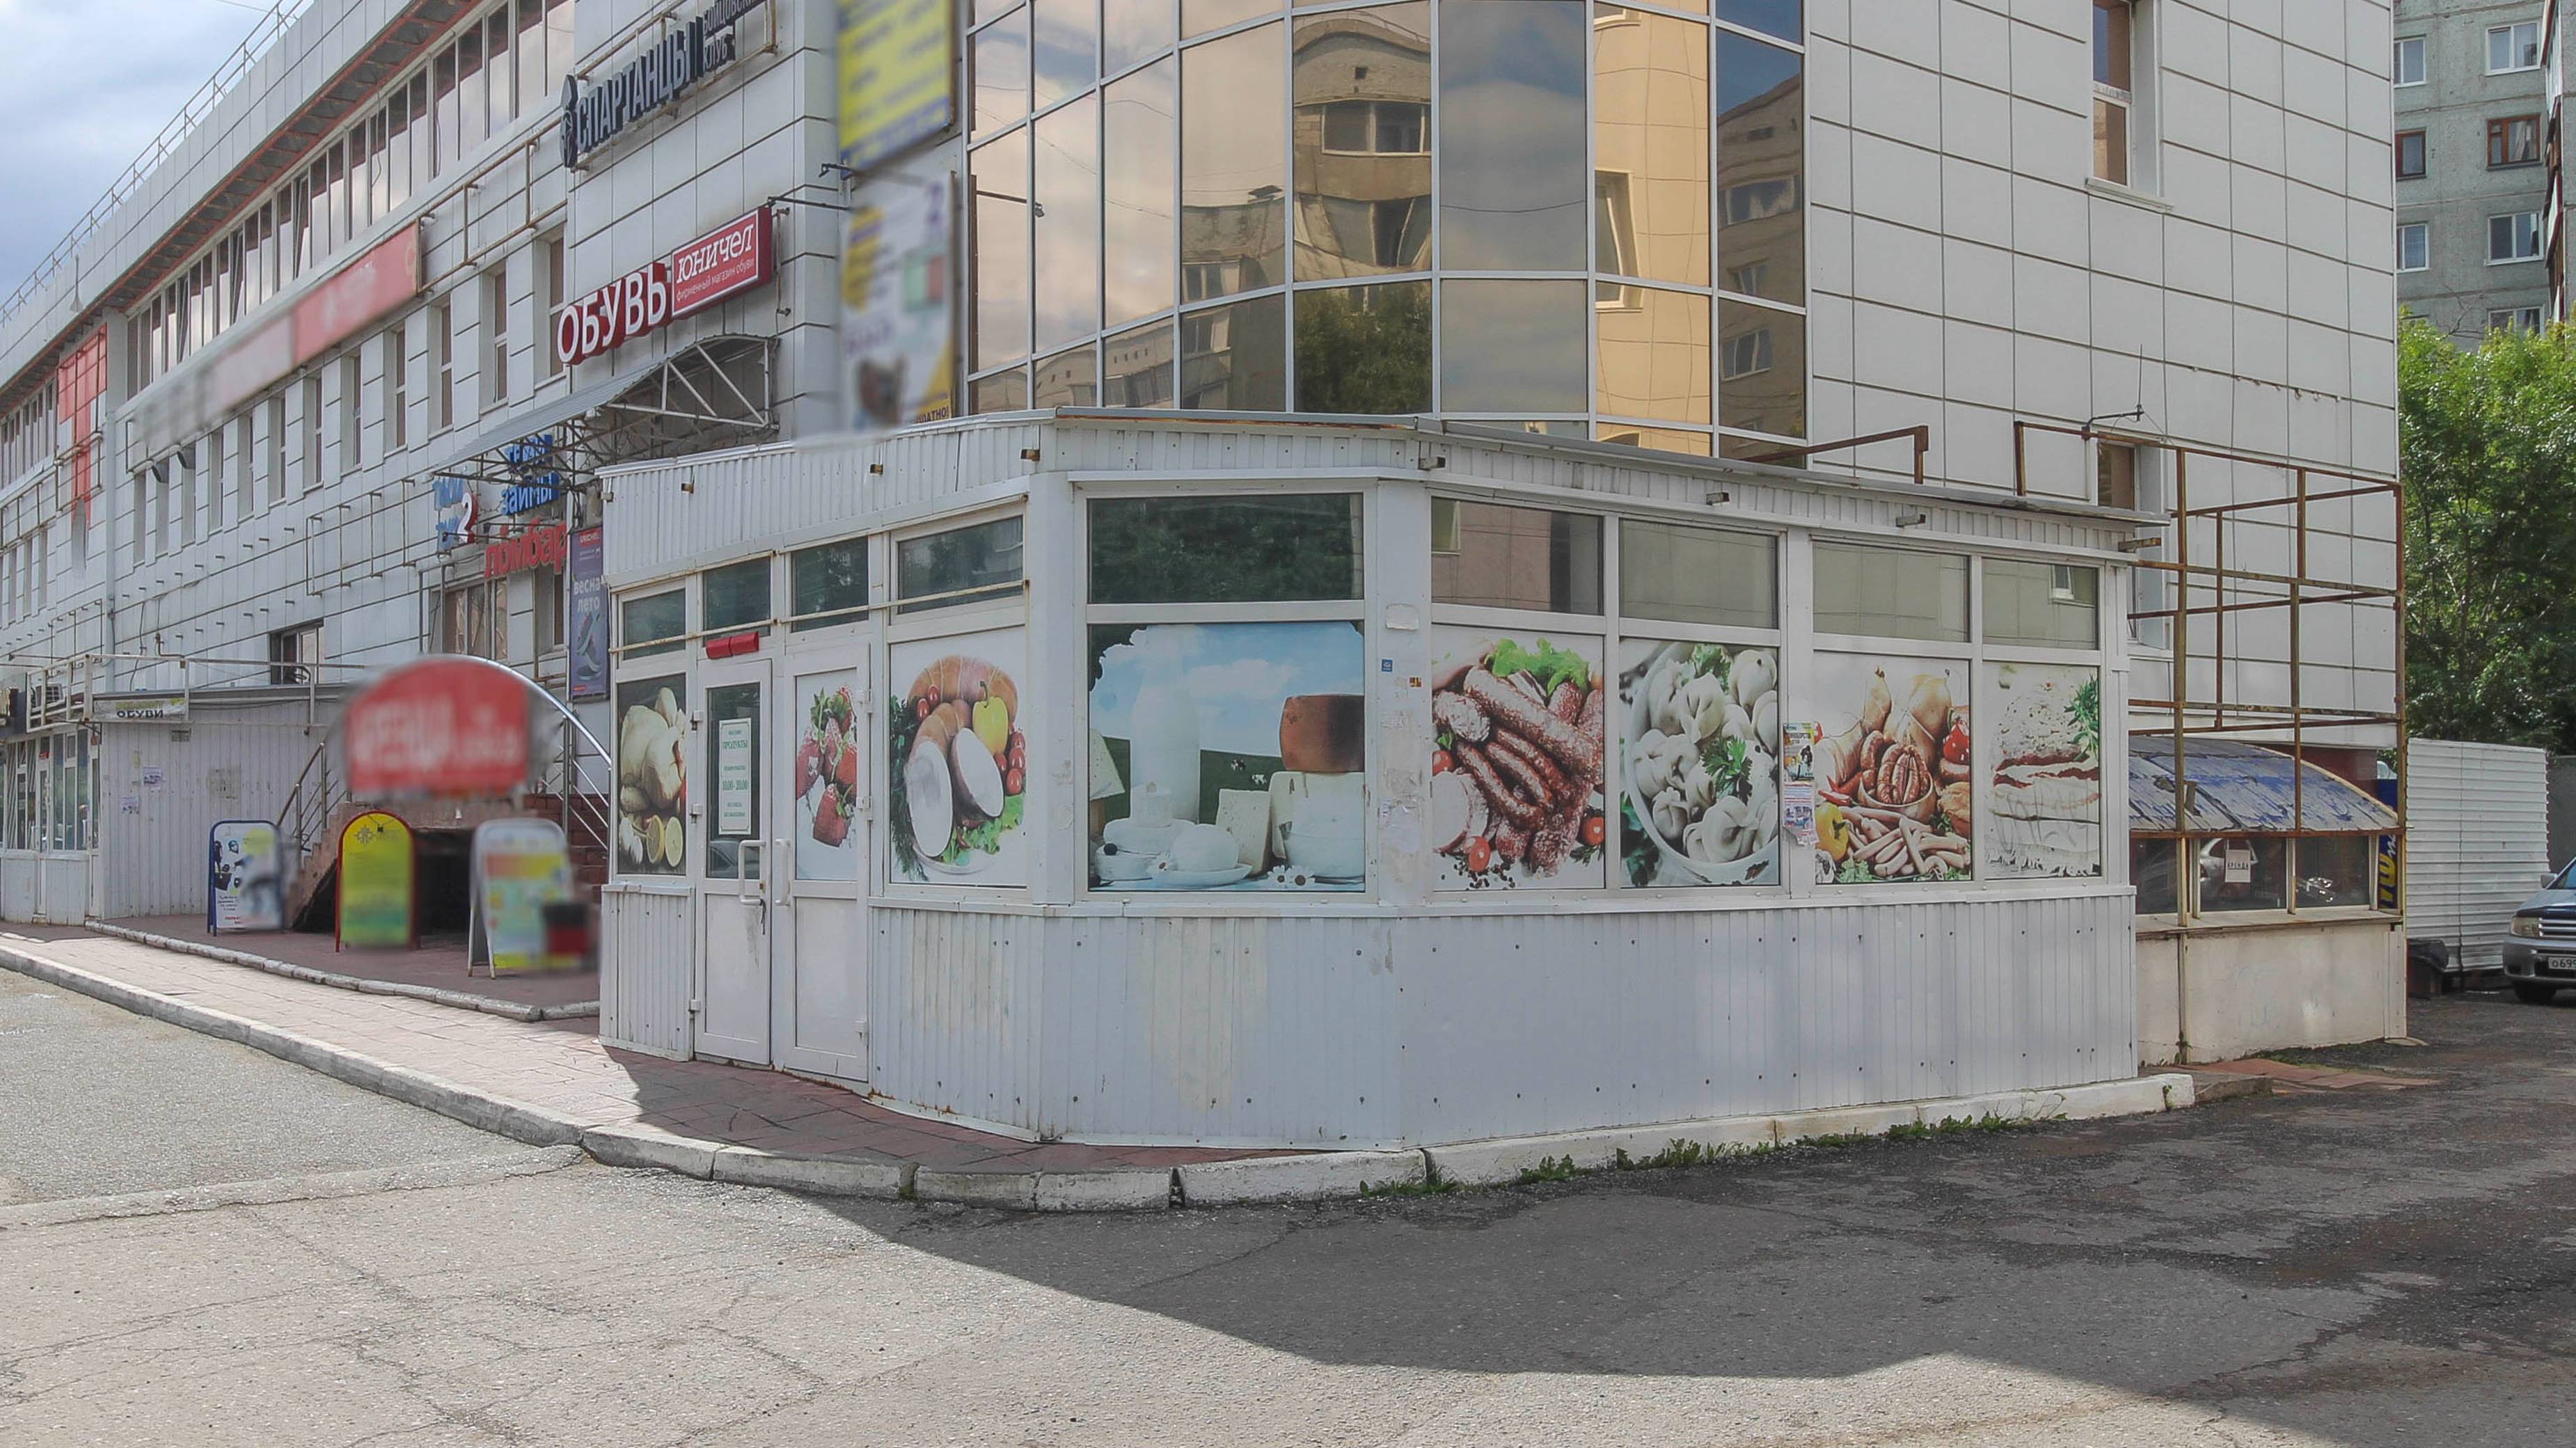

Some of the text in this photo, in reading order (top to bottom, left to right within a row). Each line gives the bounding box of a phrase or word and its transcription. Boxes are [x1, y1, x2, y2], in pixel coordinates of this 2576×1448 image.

[703, 34, 729, 72] КЛУБ
[576, 19, 702, 152] СПАРТАНЦЫ
[736, 258, 754, 274] обуви
[558, 262, 668, 363] ОБУВЬ
[577, 596, 600, 613] лето
[116, 709, 164, 718] ОБУВИ
